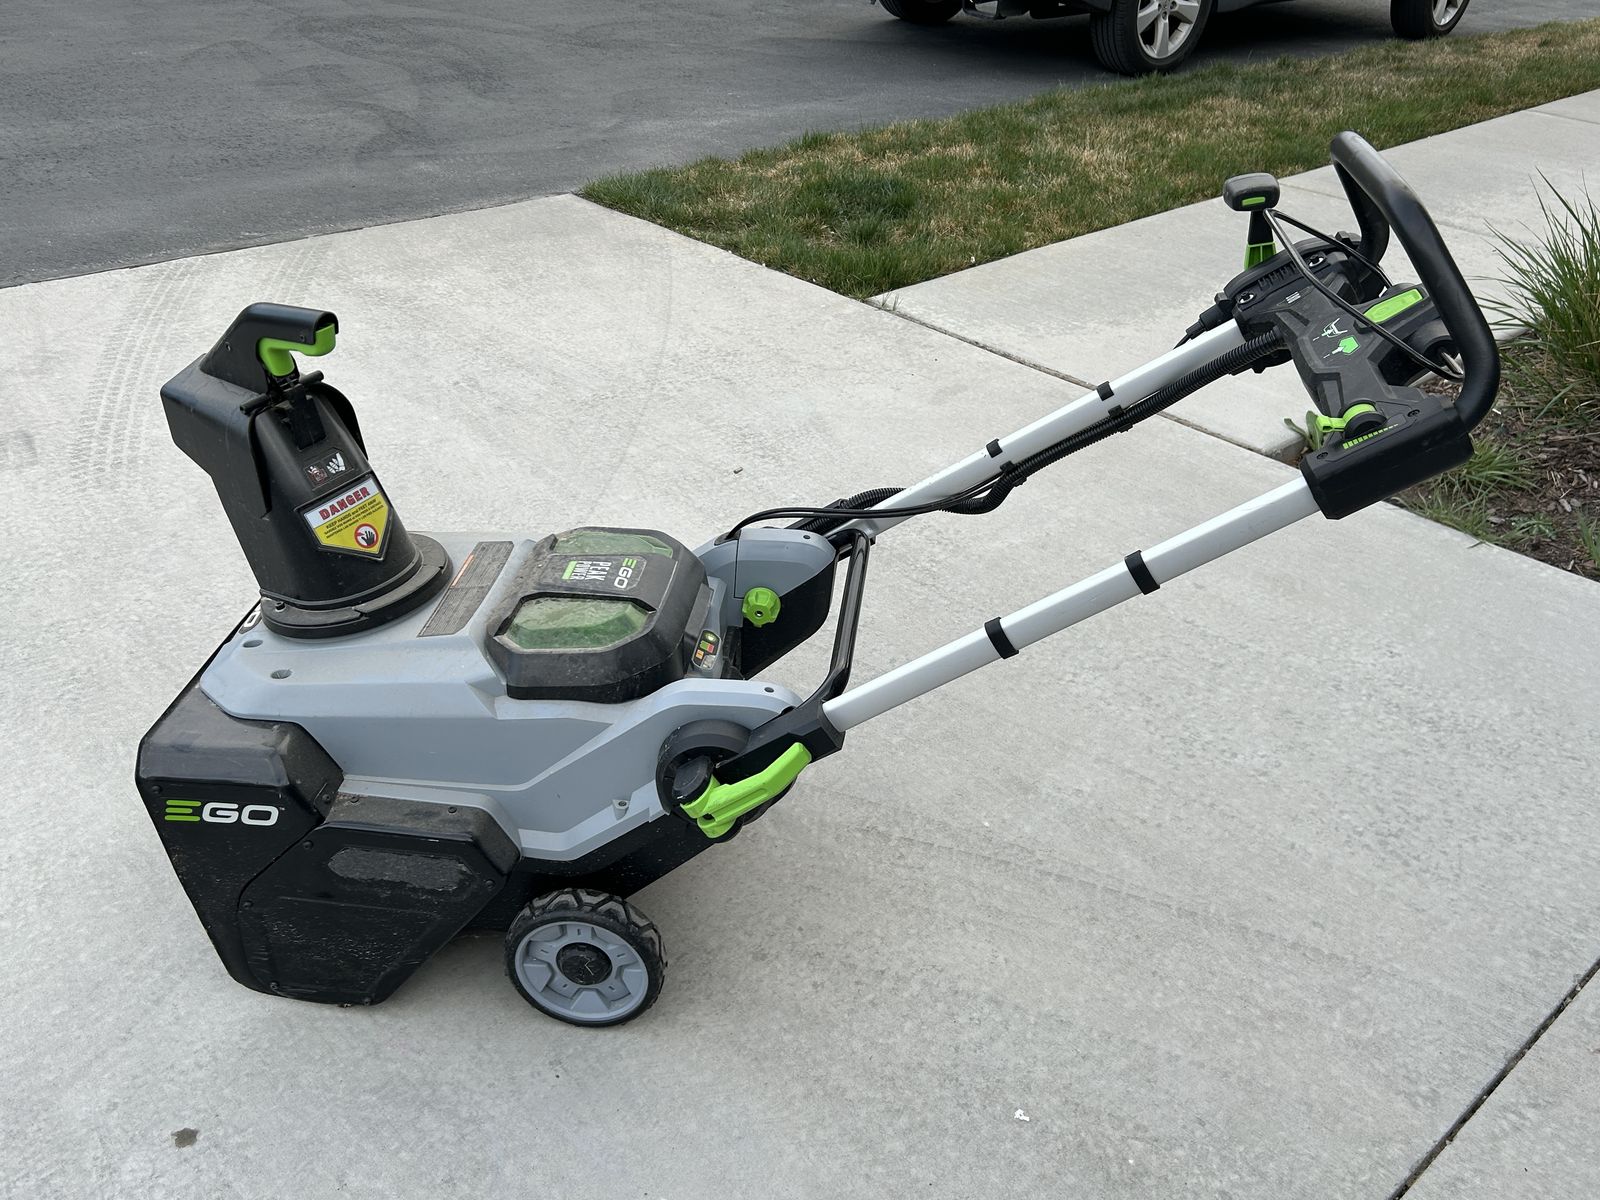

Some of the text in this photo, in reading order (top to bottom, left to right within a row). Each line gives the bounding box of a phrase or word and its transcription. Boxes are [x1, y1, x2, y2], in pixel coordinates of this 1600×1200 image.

[319, 487, 370, 520] DANGER
[570, 560, 593, 580] POWER
[585, 561, 612, 581] PEAK
[614, 558, 637, 588] EGO
[164, 799, 279, 826] EGO
